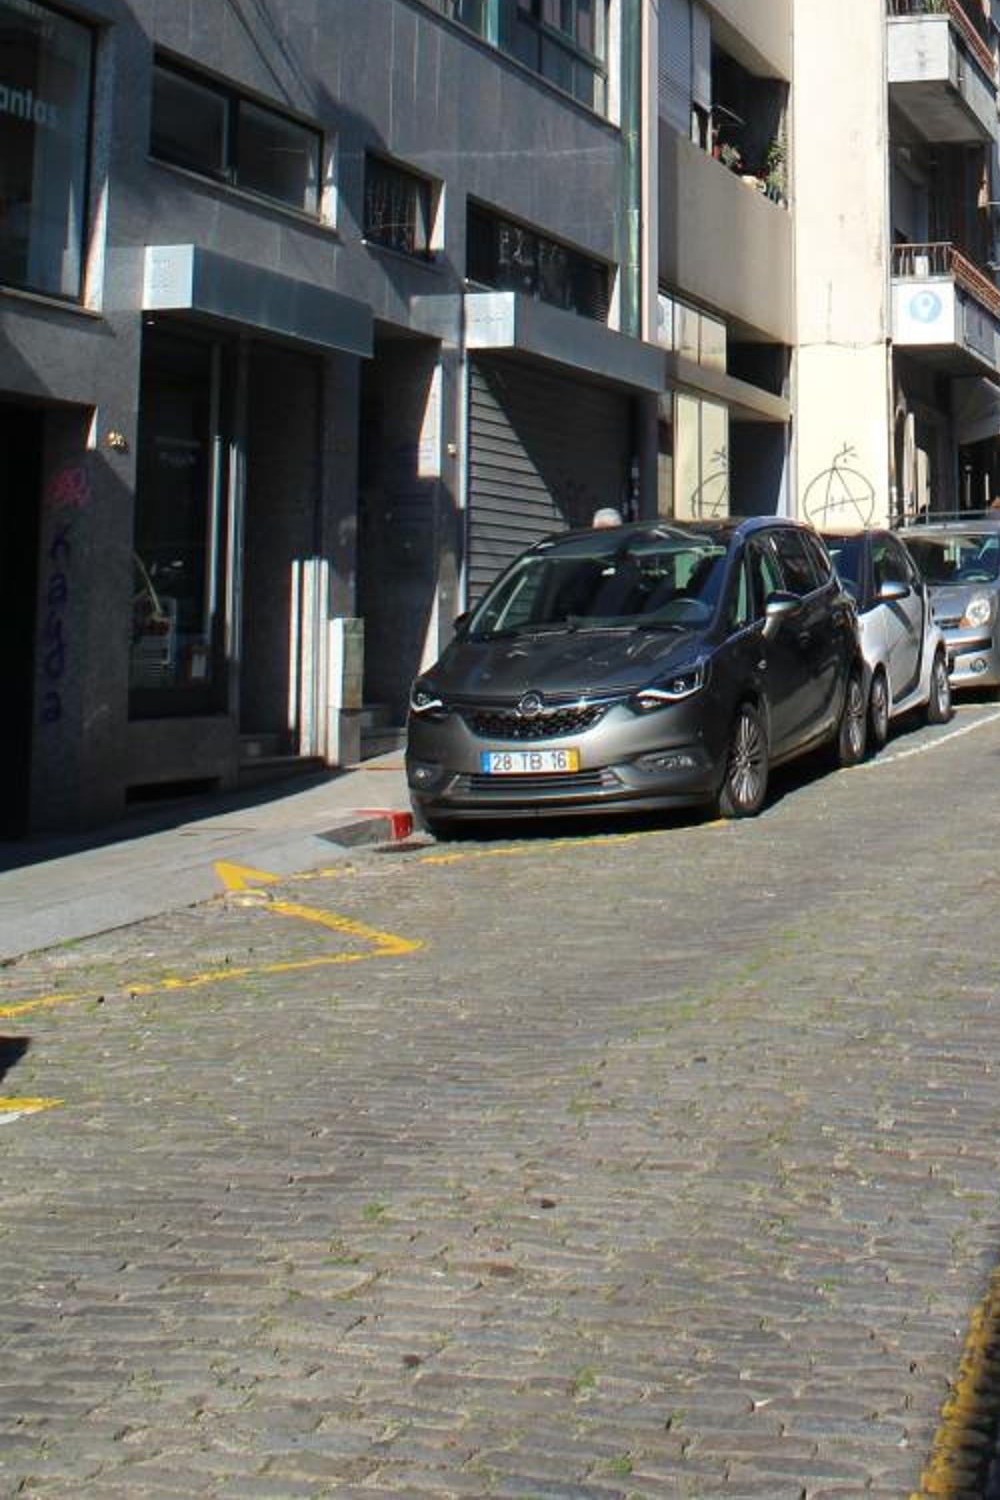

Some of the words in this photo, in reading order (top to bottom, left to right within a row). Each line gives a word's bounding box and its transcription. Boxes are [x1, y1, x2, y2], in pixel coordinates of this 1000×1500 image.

[493, 753, 512, 771] 28
[521, 752, 543, 770] TB
[551, 750, 567, 769] 16
